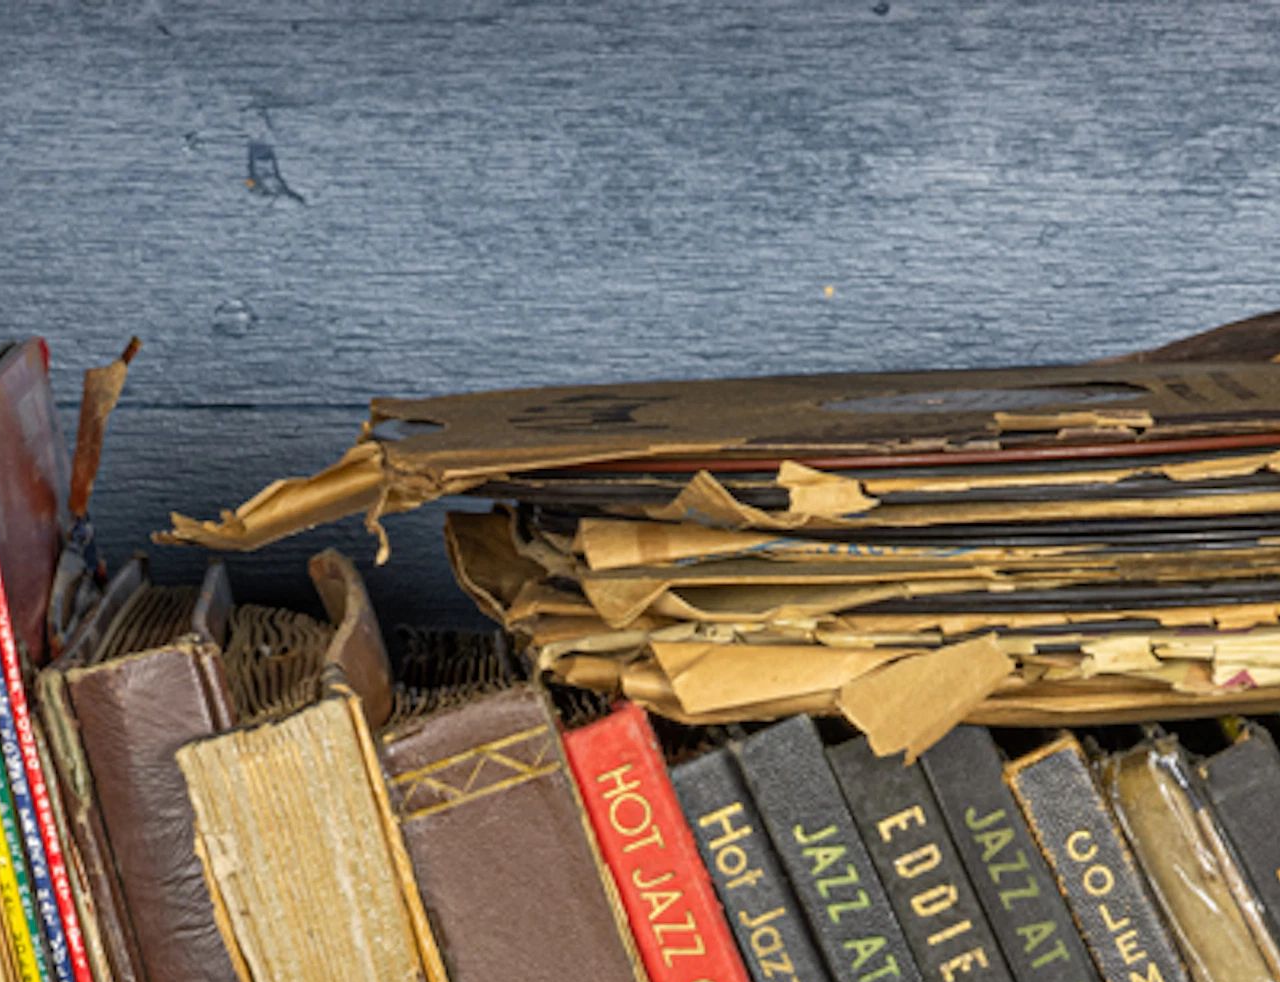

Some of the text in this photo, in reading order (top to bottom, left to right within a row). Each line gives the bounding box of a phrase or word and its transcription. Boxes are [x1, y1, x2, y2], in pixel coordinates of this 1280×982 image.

[597, 764, 663, 852] HOT
[631, 869, 705, 967] JAZZ
[698, 802, 763, 888] Hot
[792, 824, 869, 923] JAZZ
[877, 805, 988, 982] EDDIE
[965, 807, 1039, 909] JAZZ
[1016, 920, 1069, 968] AT
